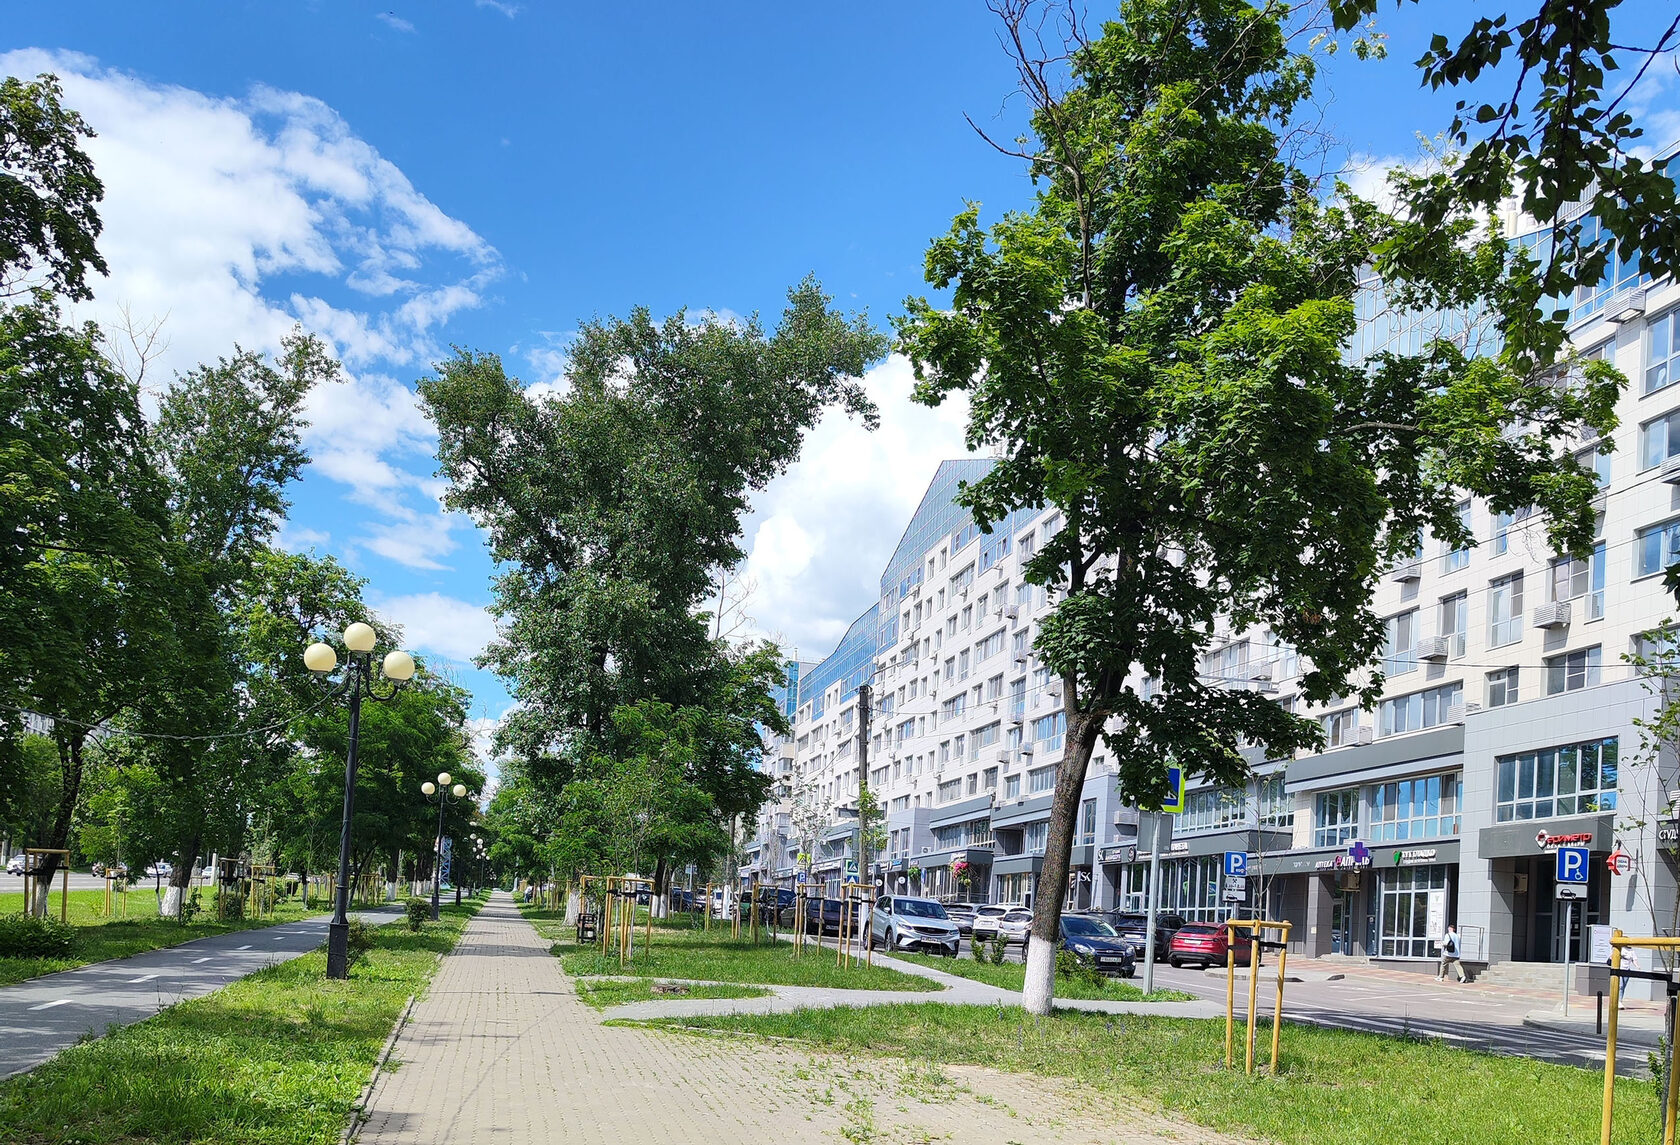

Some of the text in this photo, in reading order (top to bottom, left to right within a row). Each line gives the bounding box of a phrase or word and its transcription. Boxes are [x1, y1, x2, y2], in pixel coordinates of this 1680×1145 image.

[1658, 829, 1679, 840] СТУД
[1341, 856, 1370, 867] АПРЛЬ
[1564, 851, 1582, 878] P
